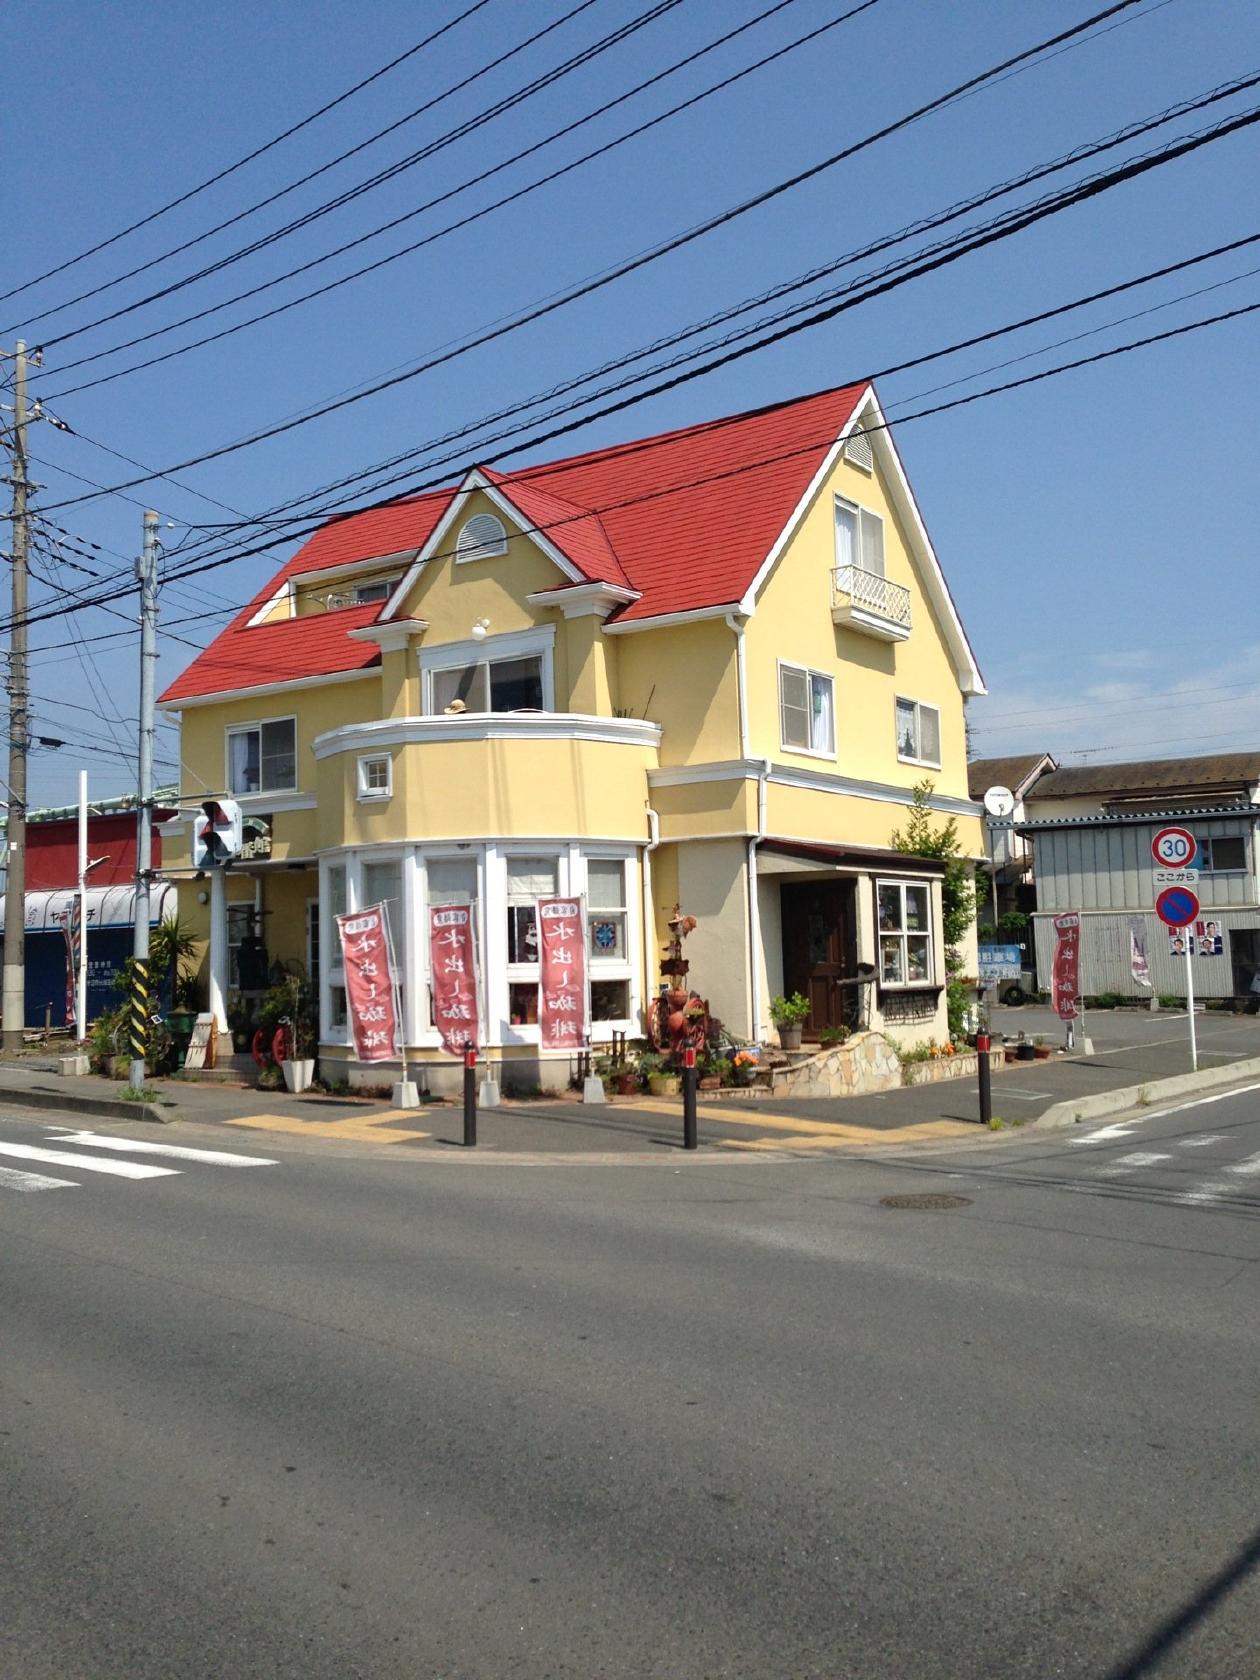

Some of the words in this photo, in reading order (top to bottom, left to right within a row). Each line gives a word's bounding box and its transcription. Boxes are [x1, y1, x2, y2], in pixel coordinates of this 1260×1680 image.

[1163, 839, 1187, 857] 30
[1157, 873, 1195, 882] ここから
